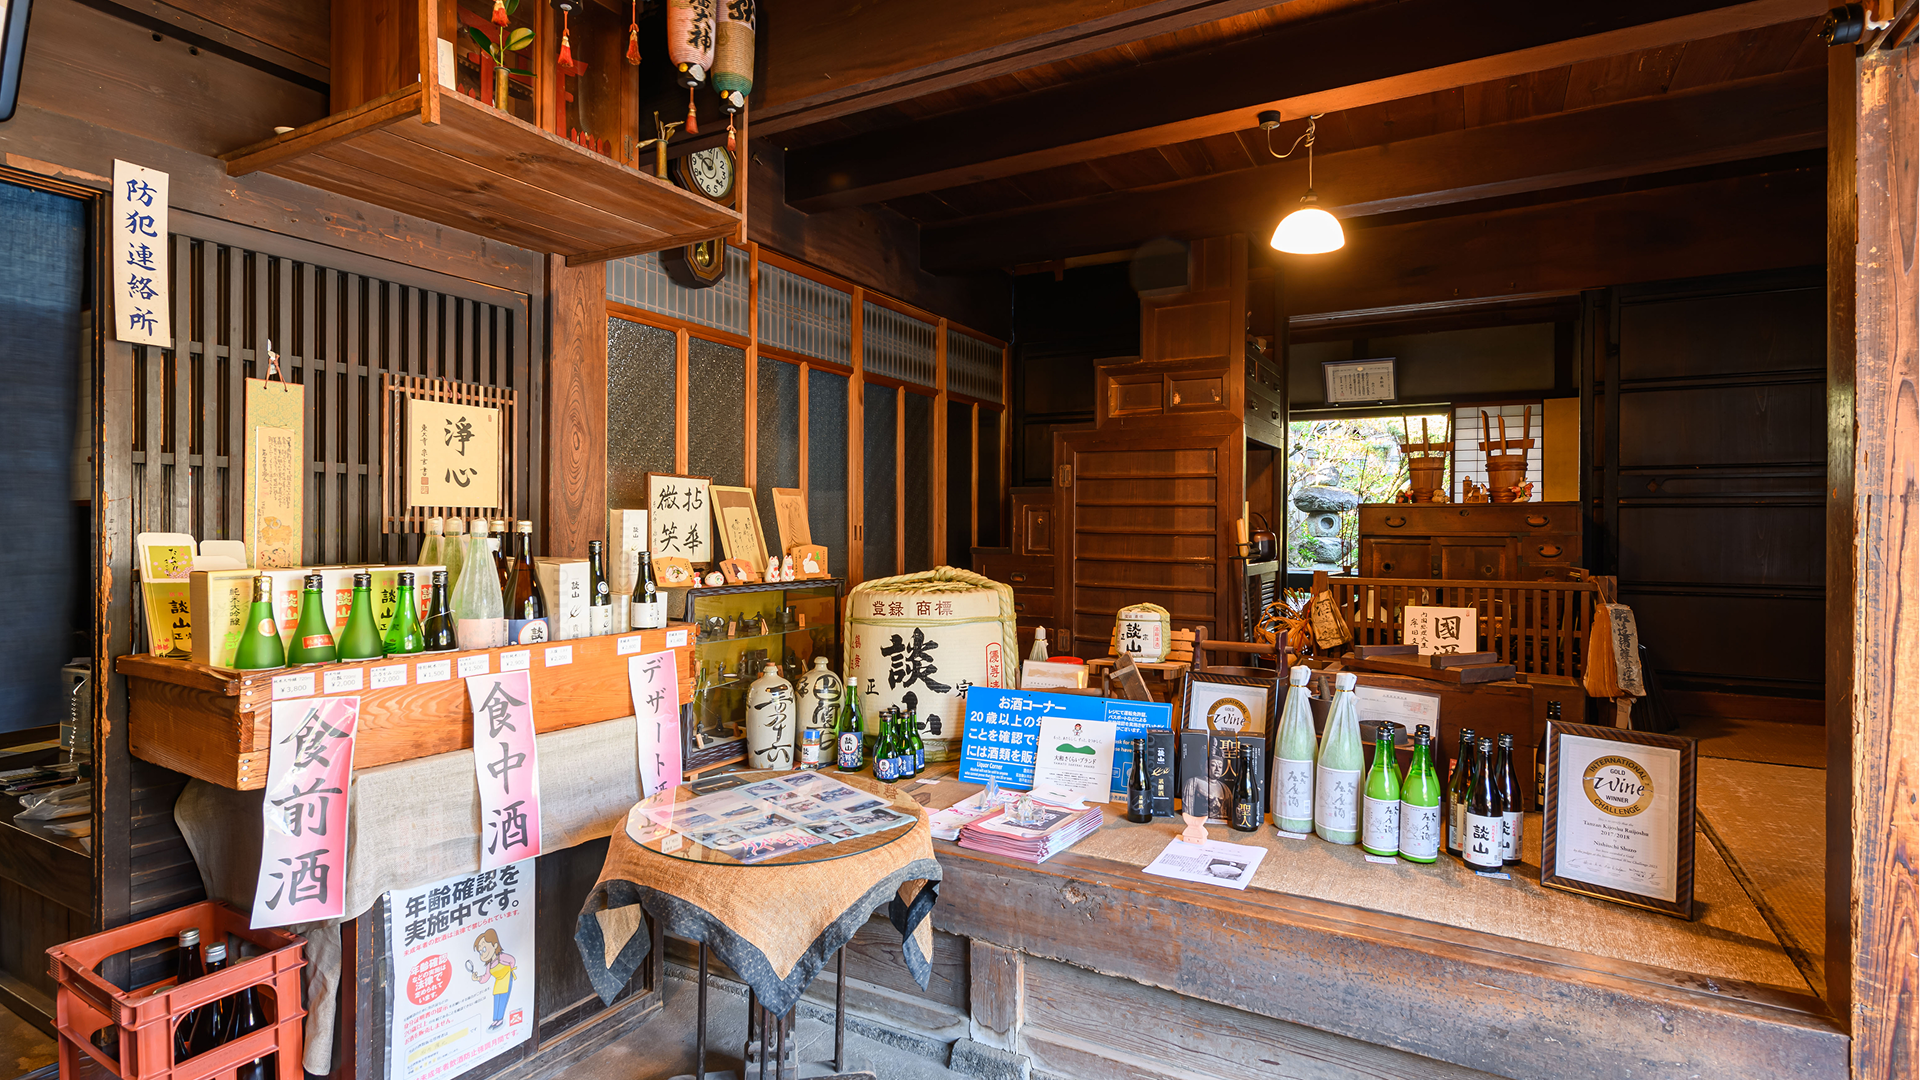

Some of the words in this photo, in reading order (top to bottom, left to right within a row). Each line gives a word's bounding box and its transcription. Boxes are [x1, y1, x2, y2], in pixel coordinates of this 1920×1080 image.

[125, 178, 159, 336] 防犯連絡所
[572, 581, 580, 598] 談山
[168, 600, 191, 629] 談山
[229, 587, 241, 626] 純米大吟醸
[281, 593, 298, 620] 談山
[336, 592, 352, 618] 談山
[381, 588, 397, 619] 談山
[1126, 622, 1143, 653] 談山
[865, 679, 880, 696] 正
[970, 711, 984, 722] 20
[998, 696, 1067, 713] お酒コーナー
[844, 737, 853, 751] 談山
[966, 744, 1037, 764] には酒類を販
[479, 681, 527, 855] 食中酒
[1054, 755, 1096, 764] 大和さくらいブランド
[1220, 739, 1241, 777] 聖人
[1589, 757, 1647, 781] INTERNATIONAL
[1610, 768, 1626, 776] GOLD
[1591, 776, 1648, 796] Wine
[265, 707, 351, 910] 食前酒
[1593, 798, 1641, 815] CHALLENGE
[1605, 794, 1629, 803] WINNER
[1240, 803, 1251, 827] 聖人
[1473, 824, 1489, 855] 談山
[1601, 830, 1630, 840] 2017/2018
[405, 865, 519, 918] 年齢確認を
[404, 888, 519, 947] 実施中です。
[404, 909, 519, 957] 未成年者の飲酒は法律で禁じられています。
[415, 972, 443, 992] 法律で
